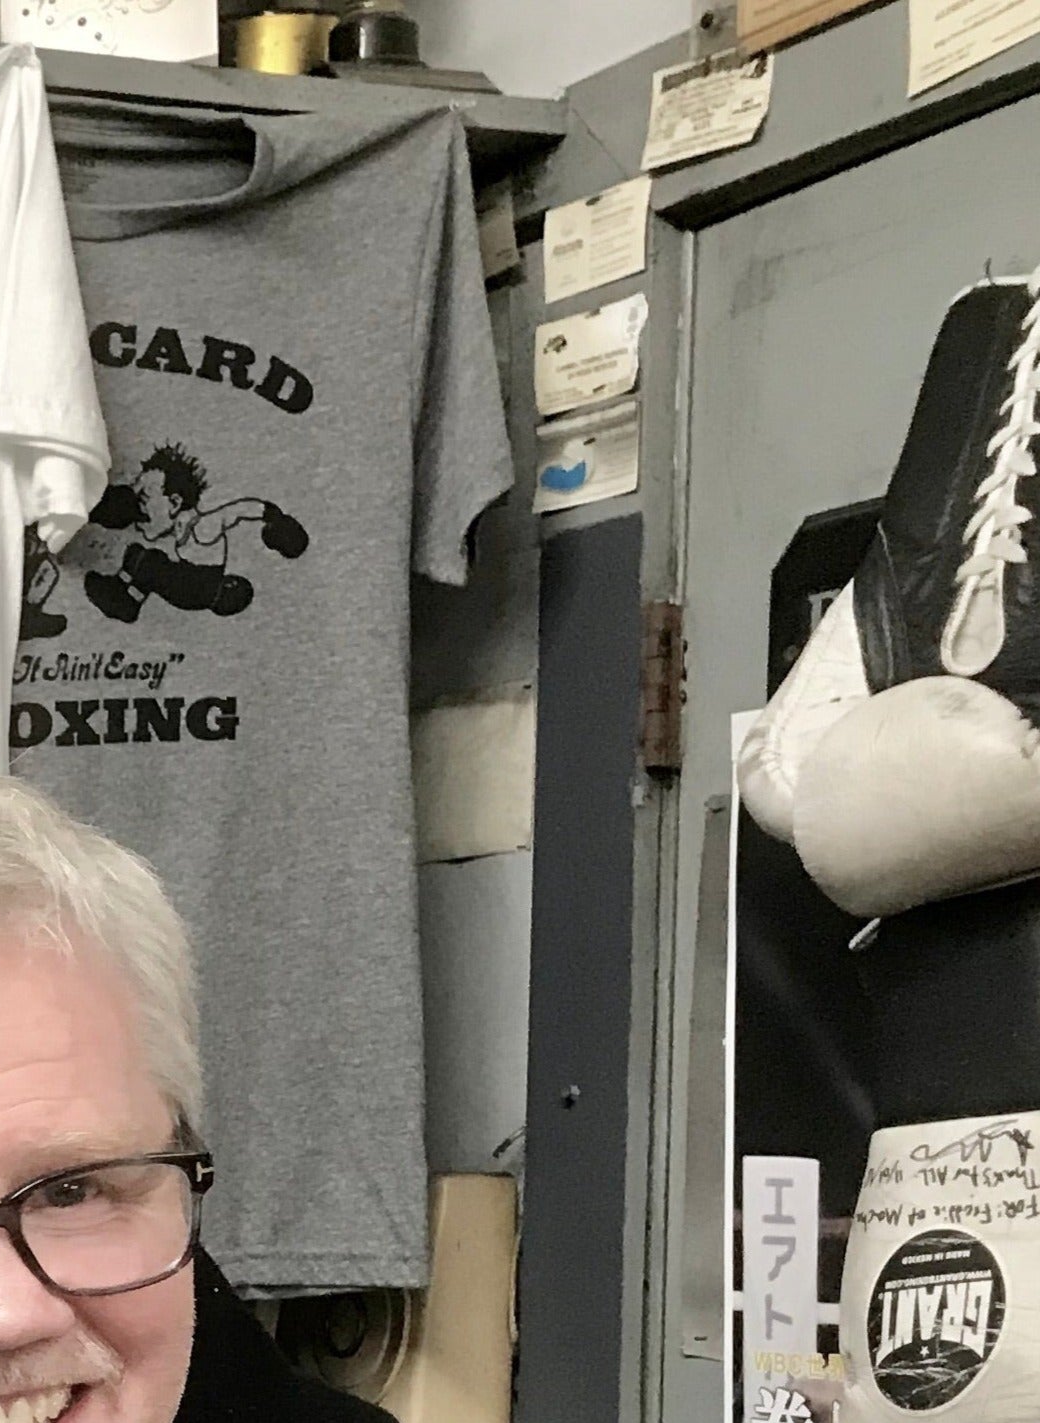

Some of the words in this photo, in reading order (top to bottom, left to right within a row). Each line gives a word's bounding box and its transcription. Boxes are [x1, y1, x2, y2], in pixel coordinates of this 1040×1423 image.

[90, 321, 315, 415] CARD
[9, 697, 240, 748] OXING
[876, 1279, 994, 1367] GRANT
